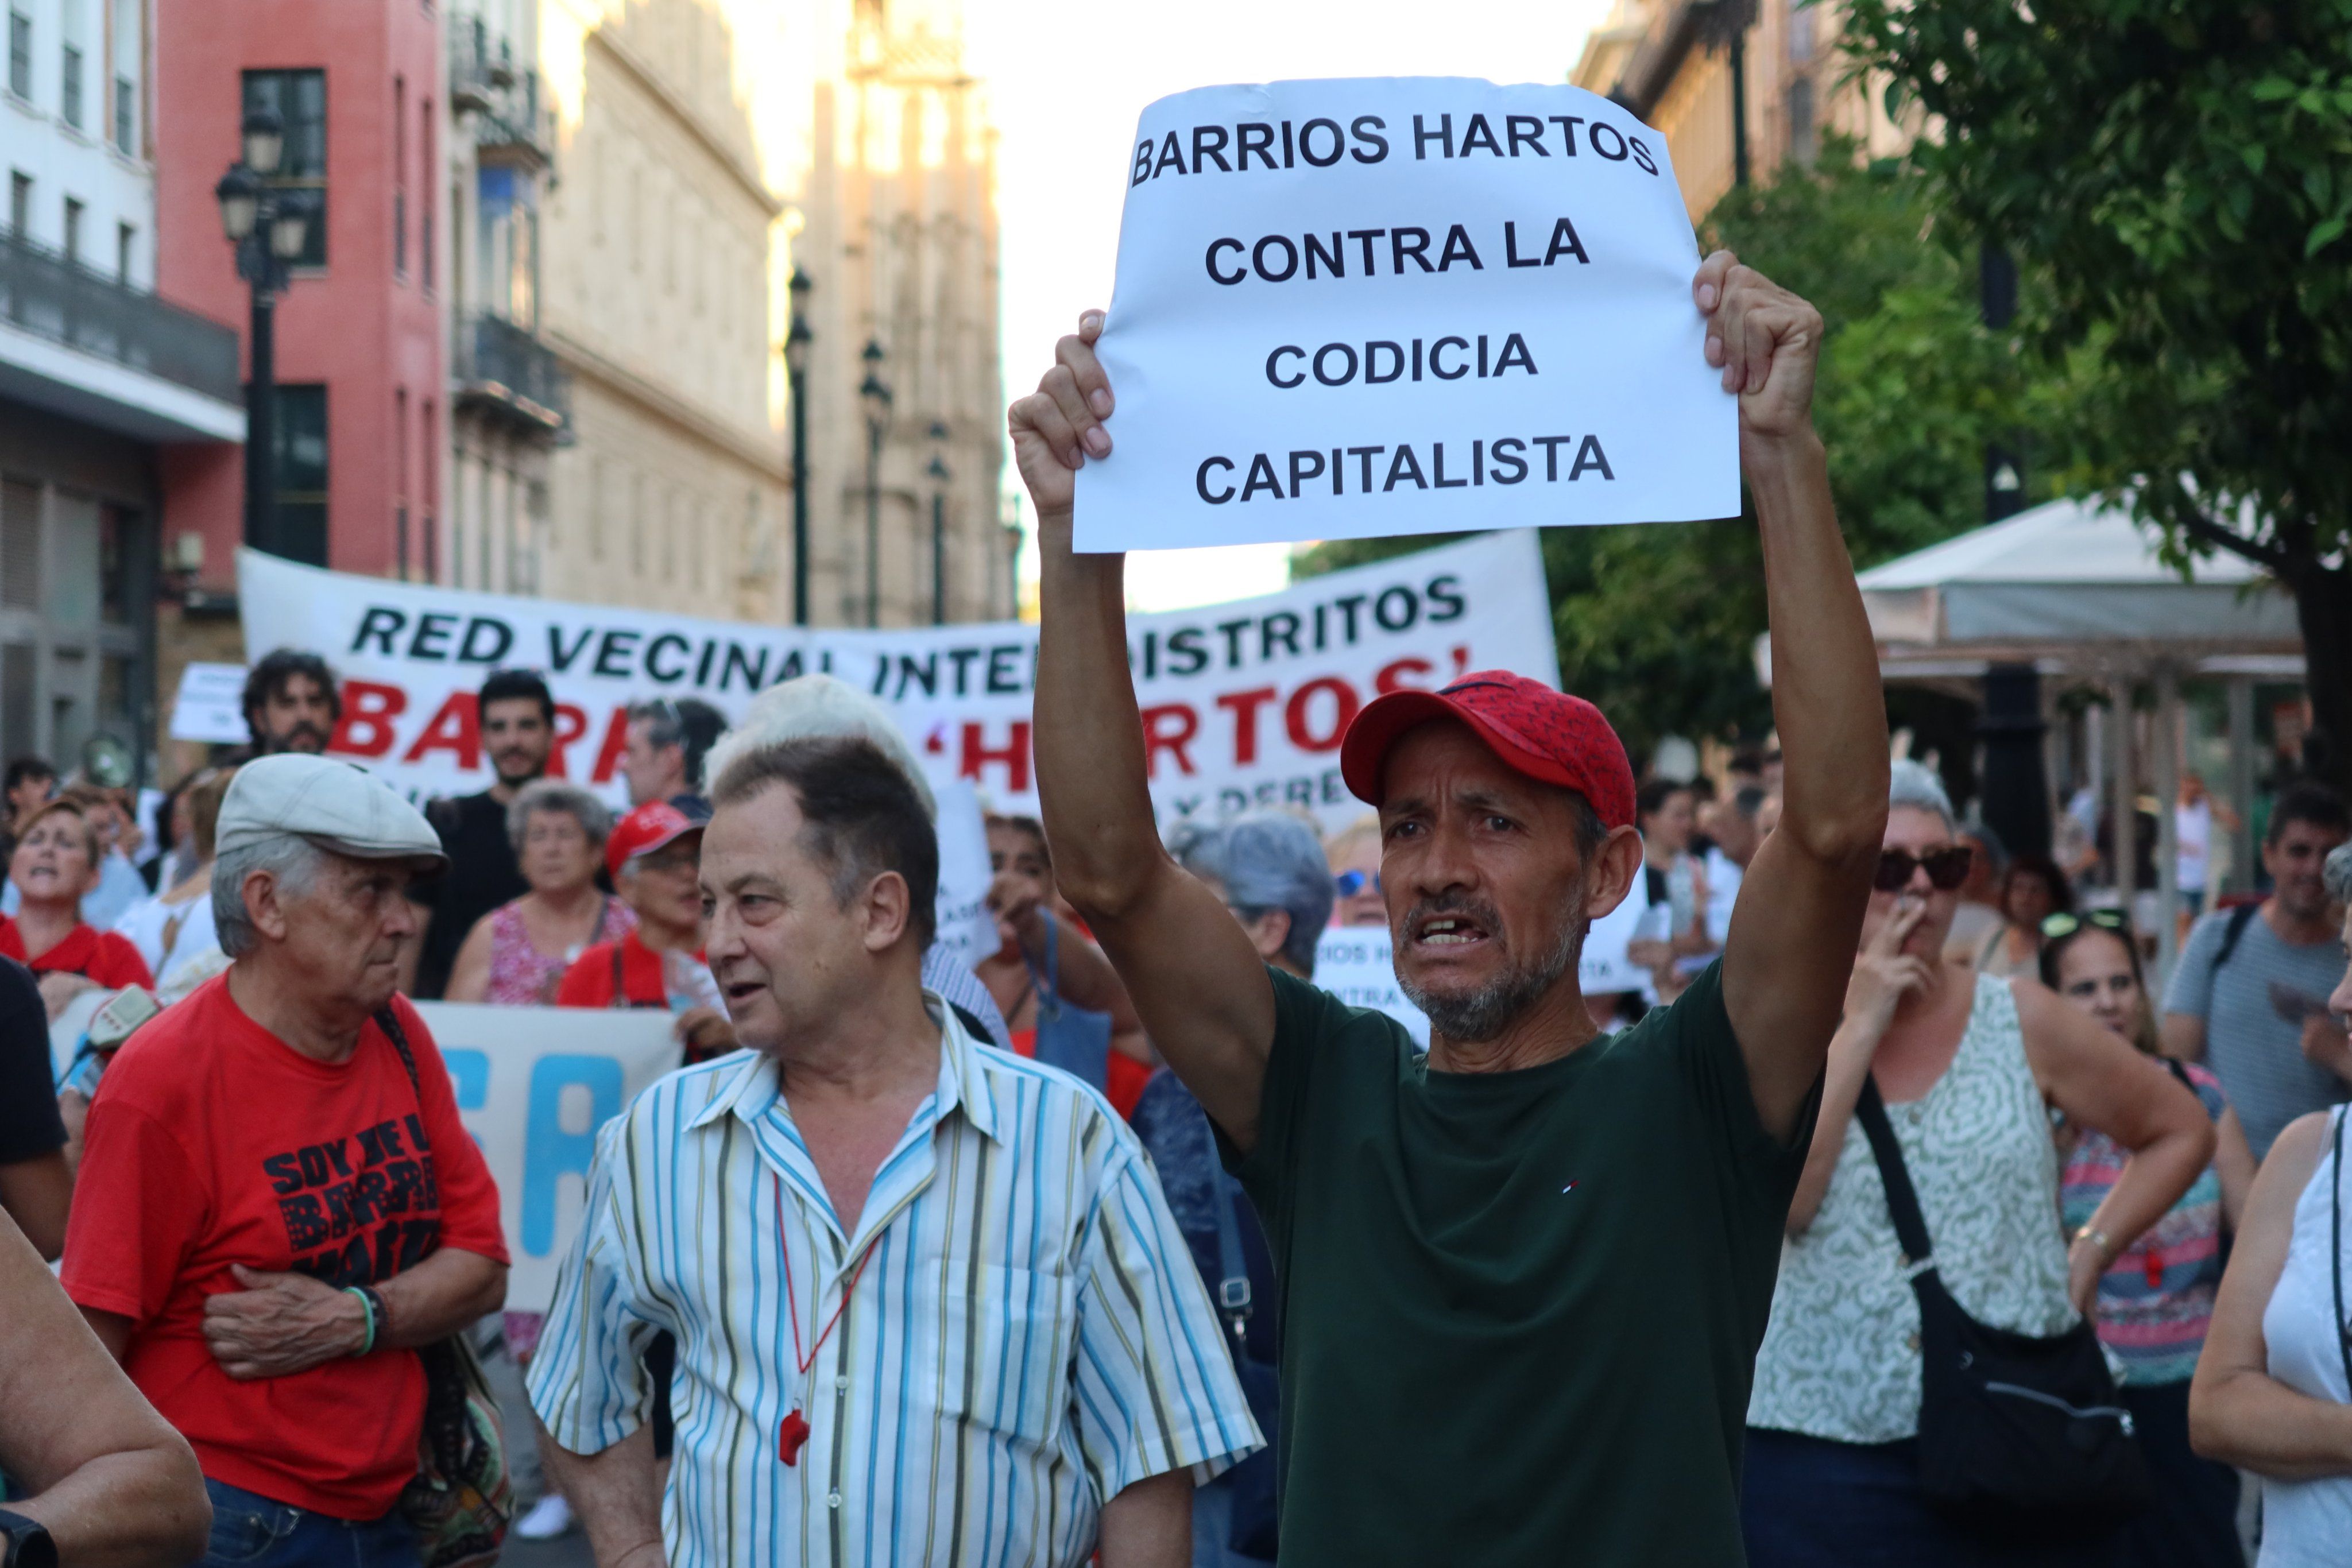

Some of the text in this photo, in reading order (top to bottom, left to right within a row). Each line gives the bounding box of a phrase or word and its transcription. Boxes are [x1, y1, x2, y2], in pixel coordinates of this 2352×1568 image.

[1132, 113, 1659, 188] BARRIOS HARTOS
[1205, 218, 1590, 286] CONTRA LA
[1265, 333, 1539, 389] CODICIA
[1196, 435, 1615, 505] CAPITALISTA
[350, 606, 513, 664] RED
[263, 1137, 354, 1195] SOY
